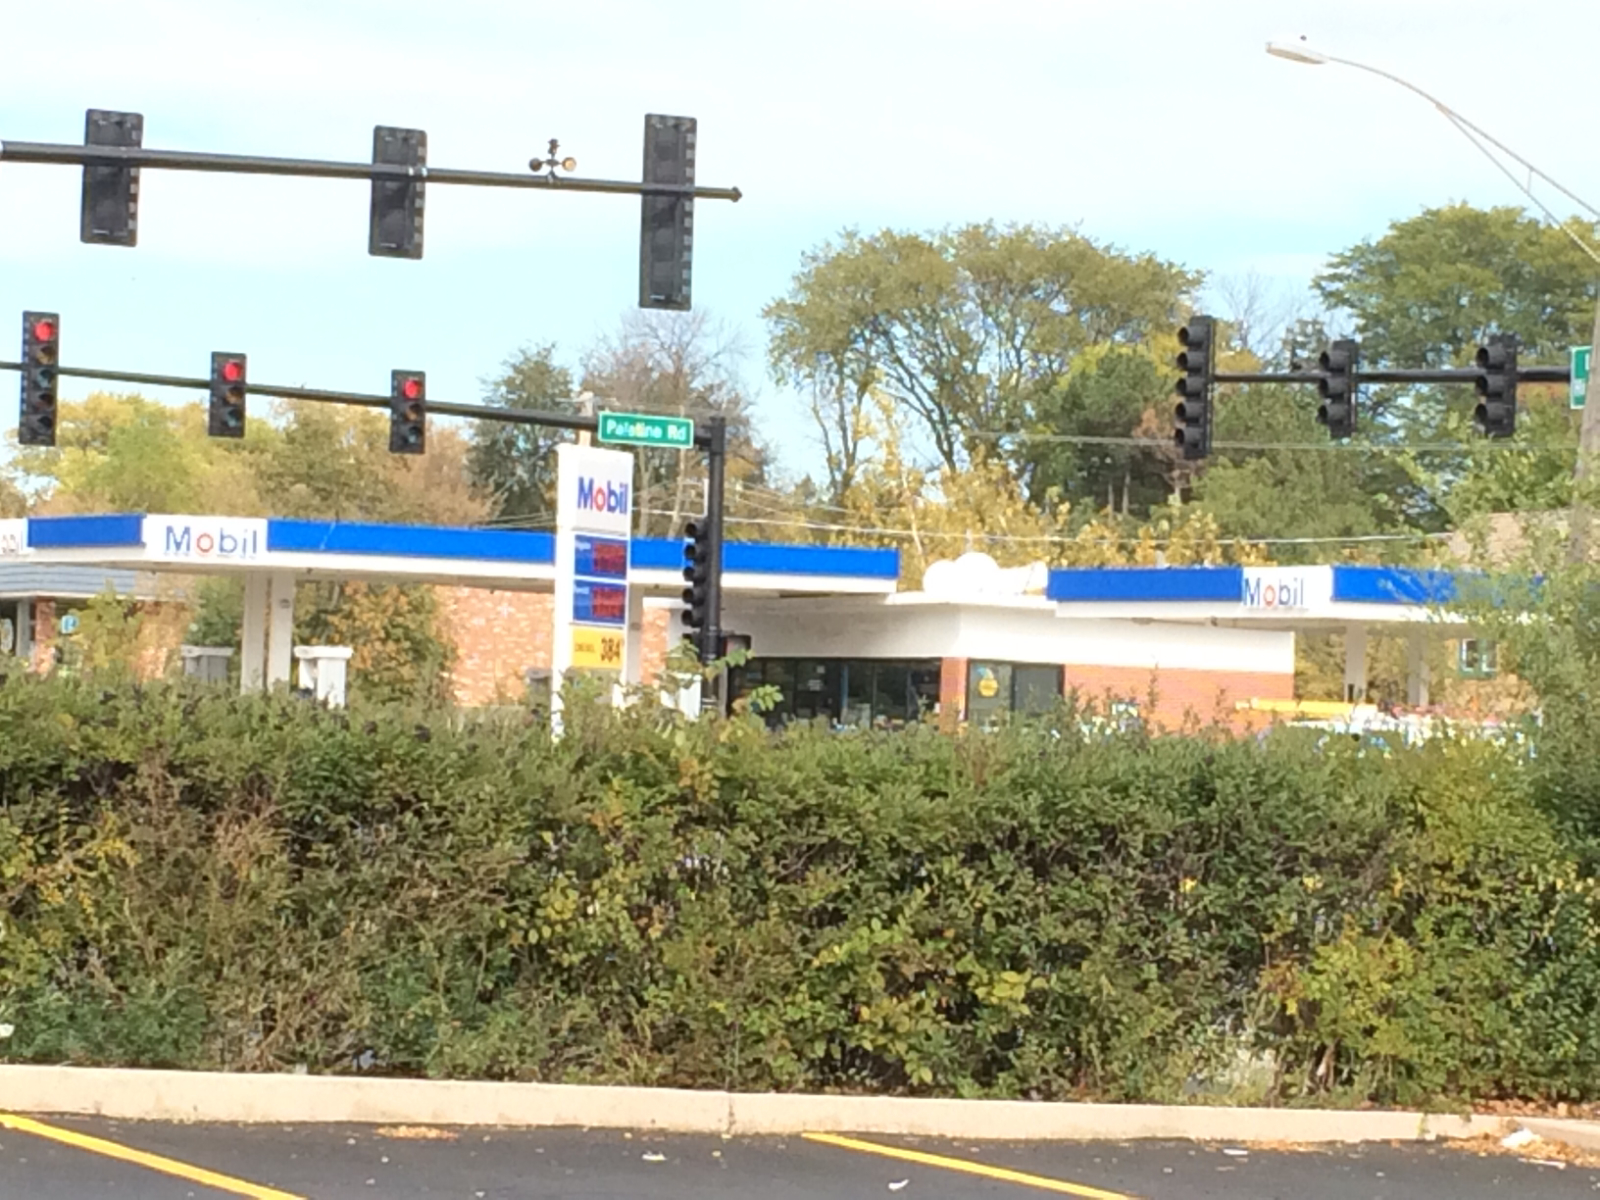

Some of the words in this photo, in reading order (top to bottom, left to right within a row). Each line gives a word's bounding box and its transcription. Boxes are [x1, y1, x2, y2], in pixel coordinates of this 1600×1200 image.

[667, 424, 687, 440] Rd
[577, 476, 628, 515] Mobil
[166, 526, 257, 555] Mobil
[1244, 577, 1304, 606] Mobil
